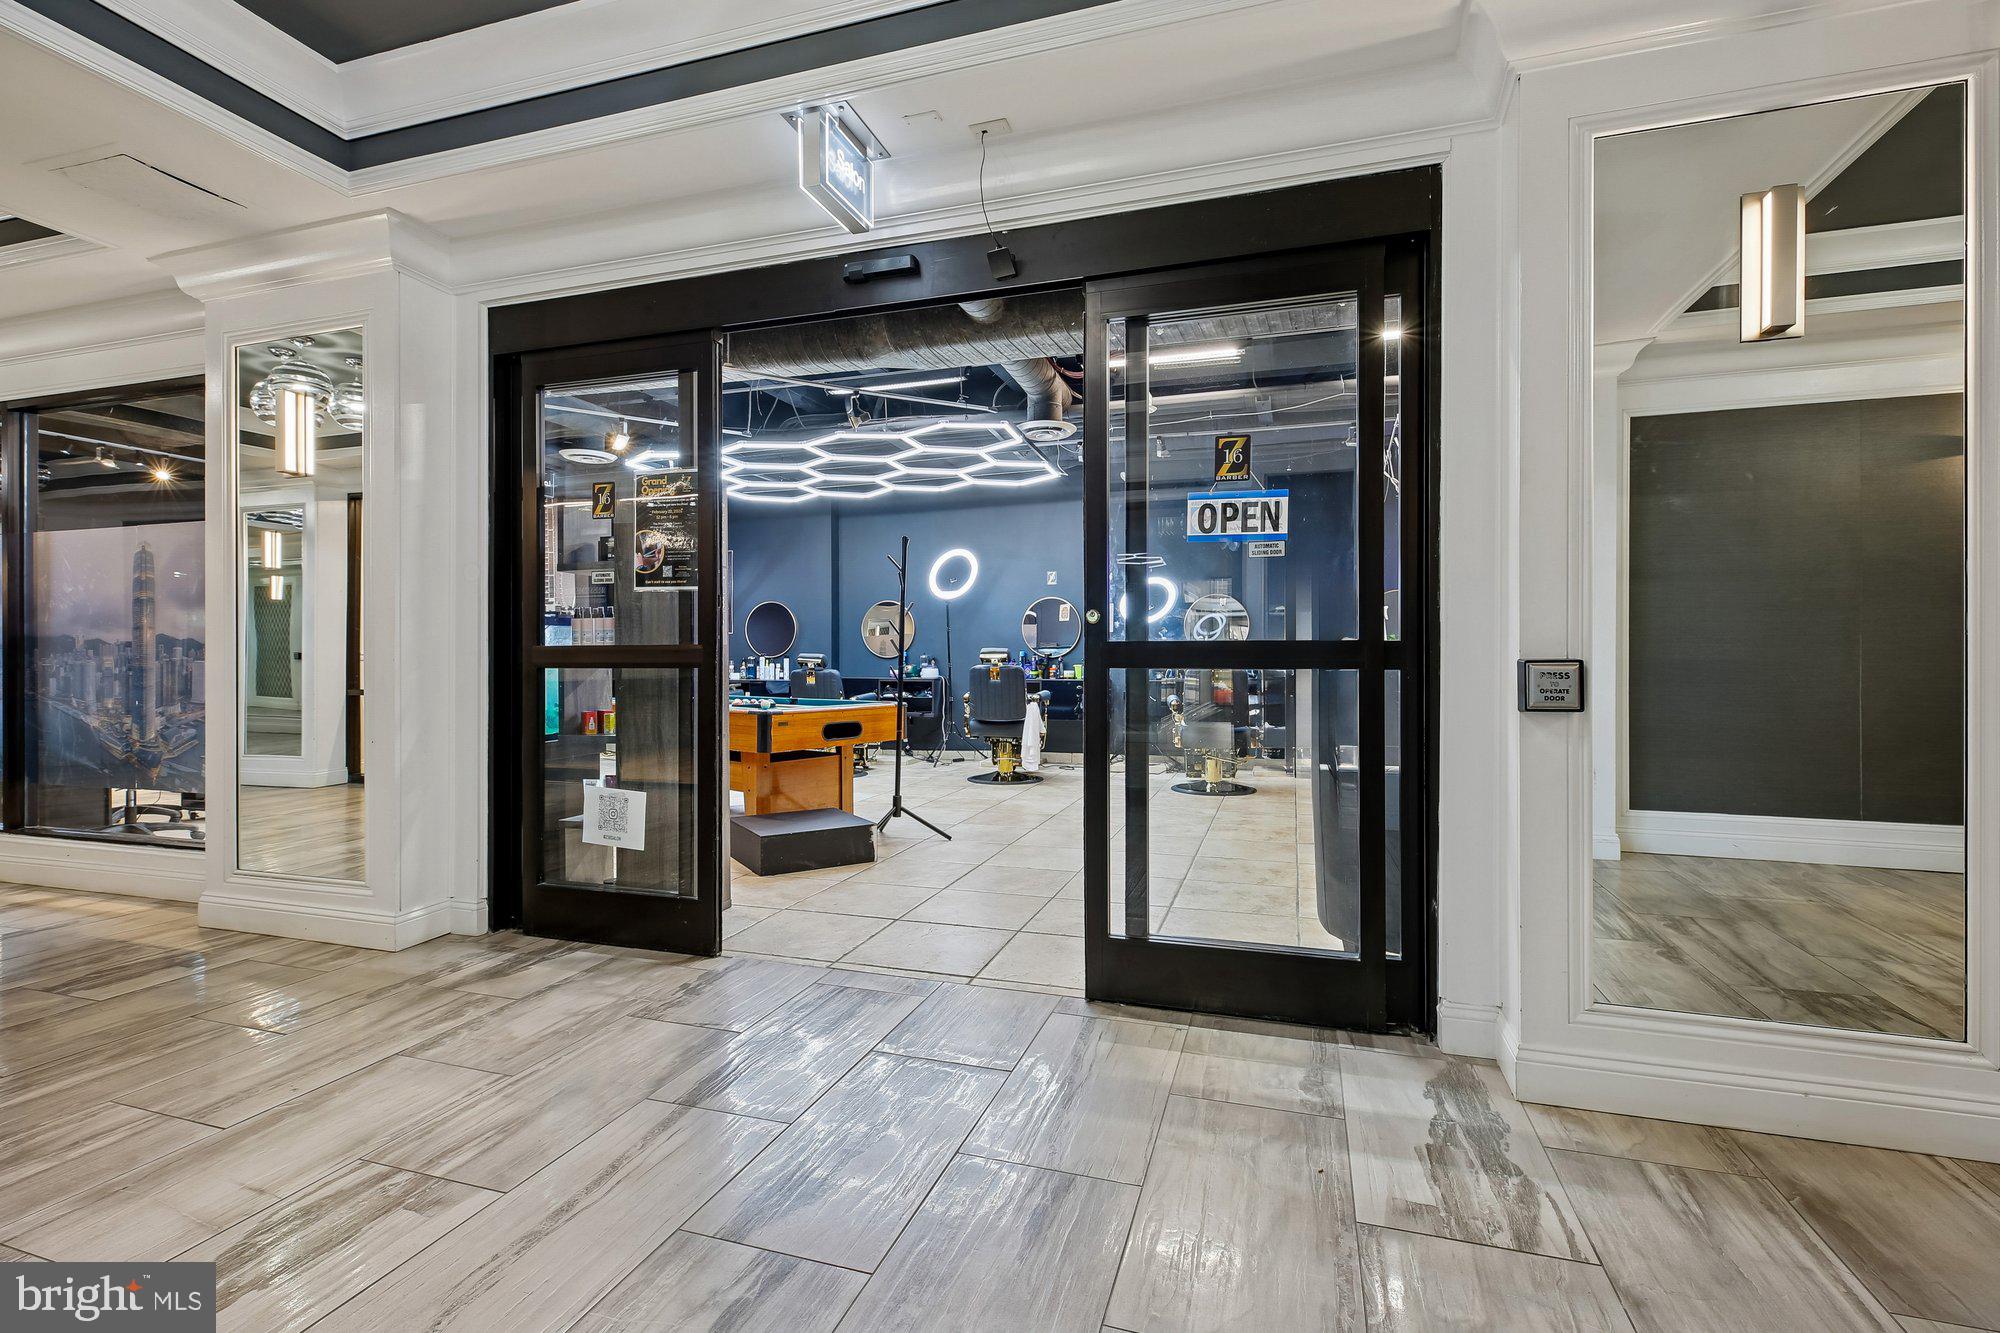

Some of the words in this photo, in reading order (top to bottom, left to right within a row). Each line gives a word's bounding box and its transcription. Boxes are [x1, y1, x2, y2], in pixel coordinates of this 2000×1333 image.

[1217, 438, 1248, 476] Z
[1223, 448, 1243, 464] 16
[642, 475, 667, 486] Grand
[642, 485, 675, 496] Opening
[598, 492, 611, 505] 16
[1198, 501, 1280, 534] OPEN
